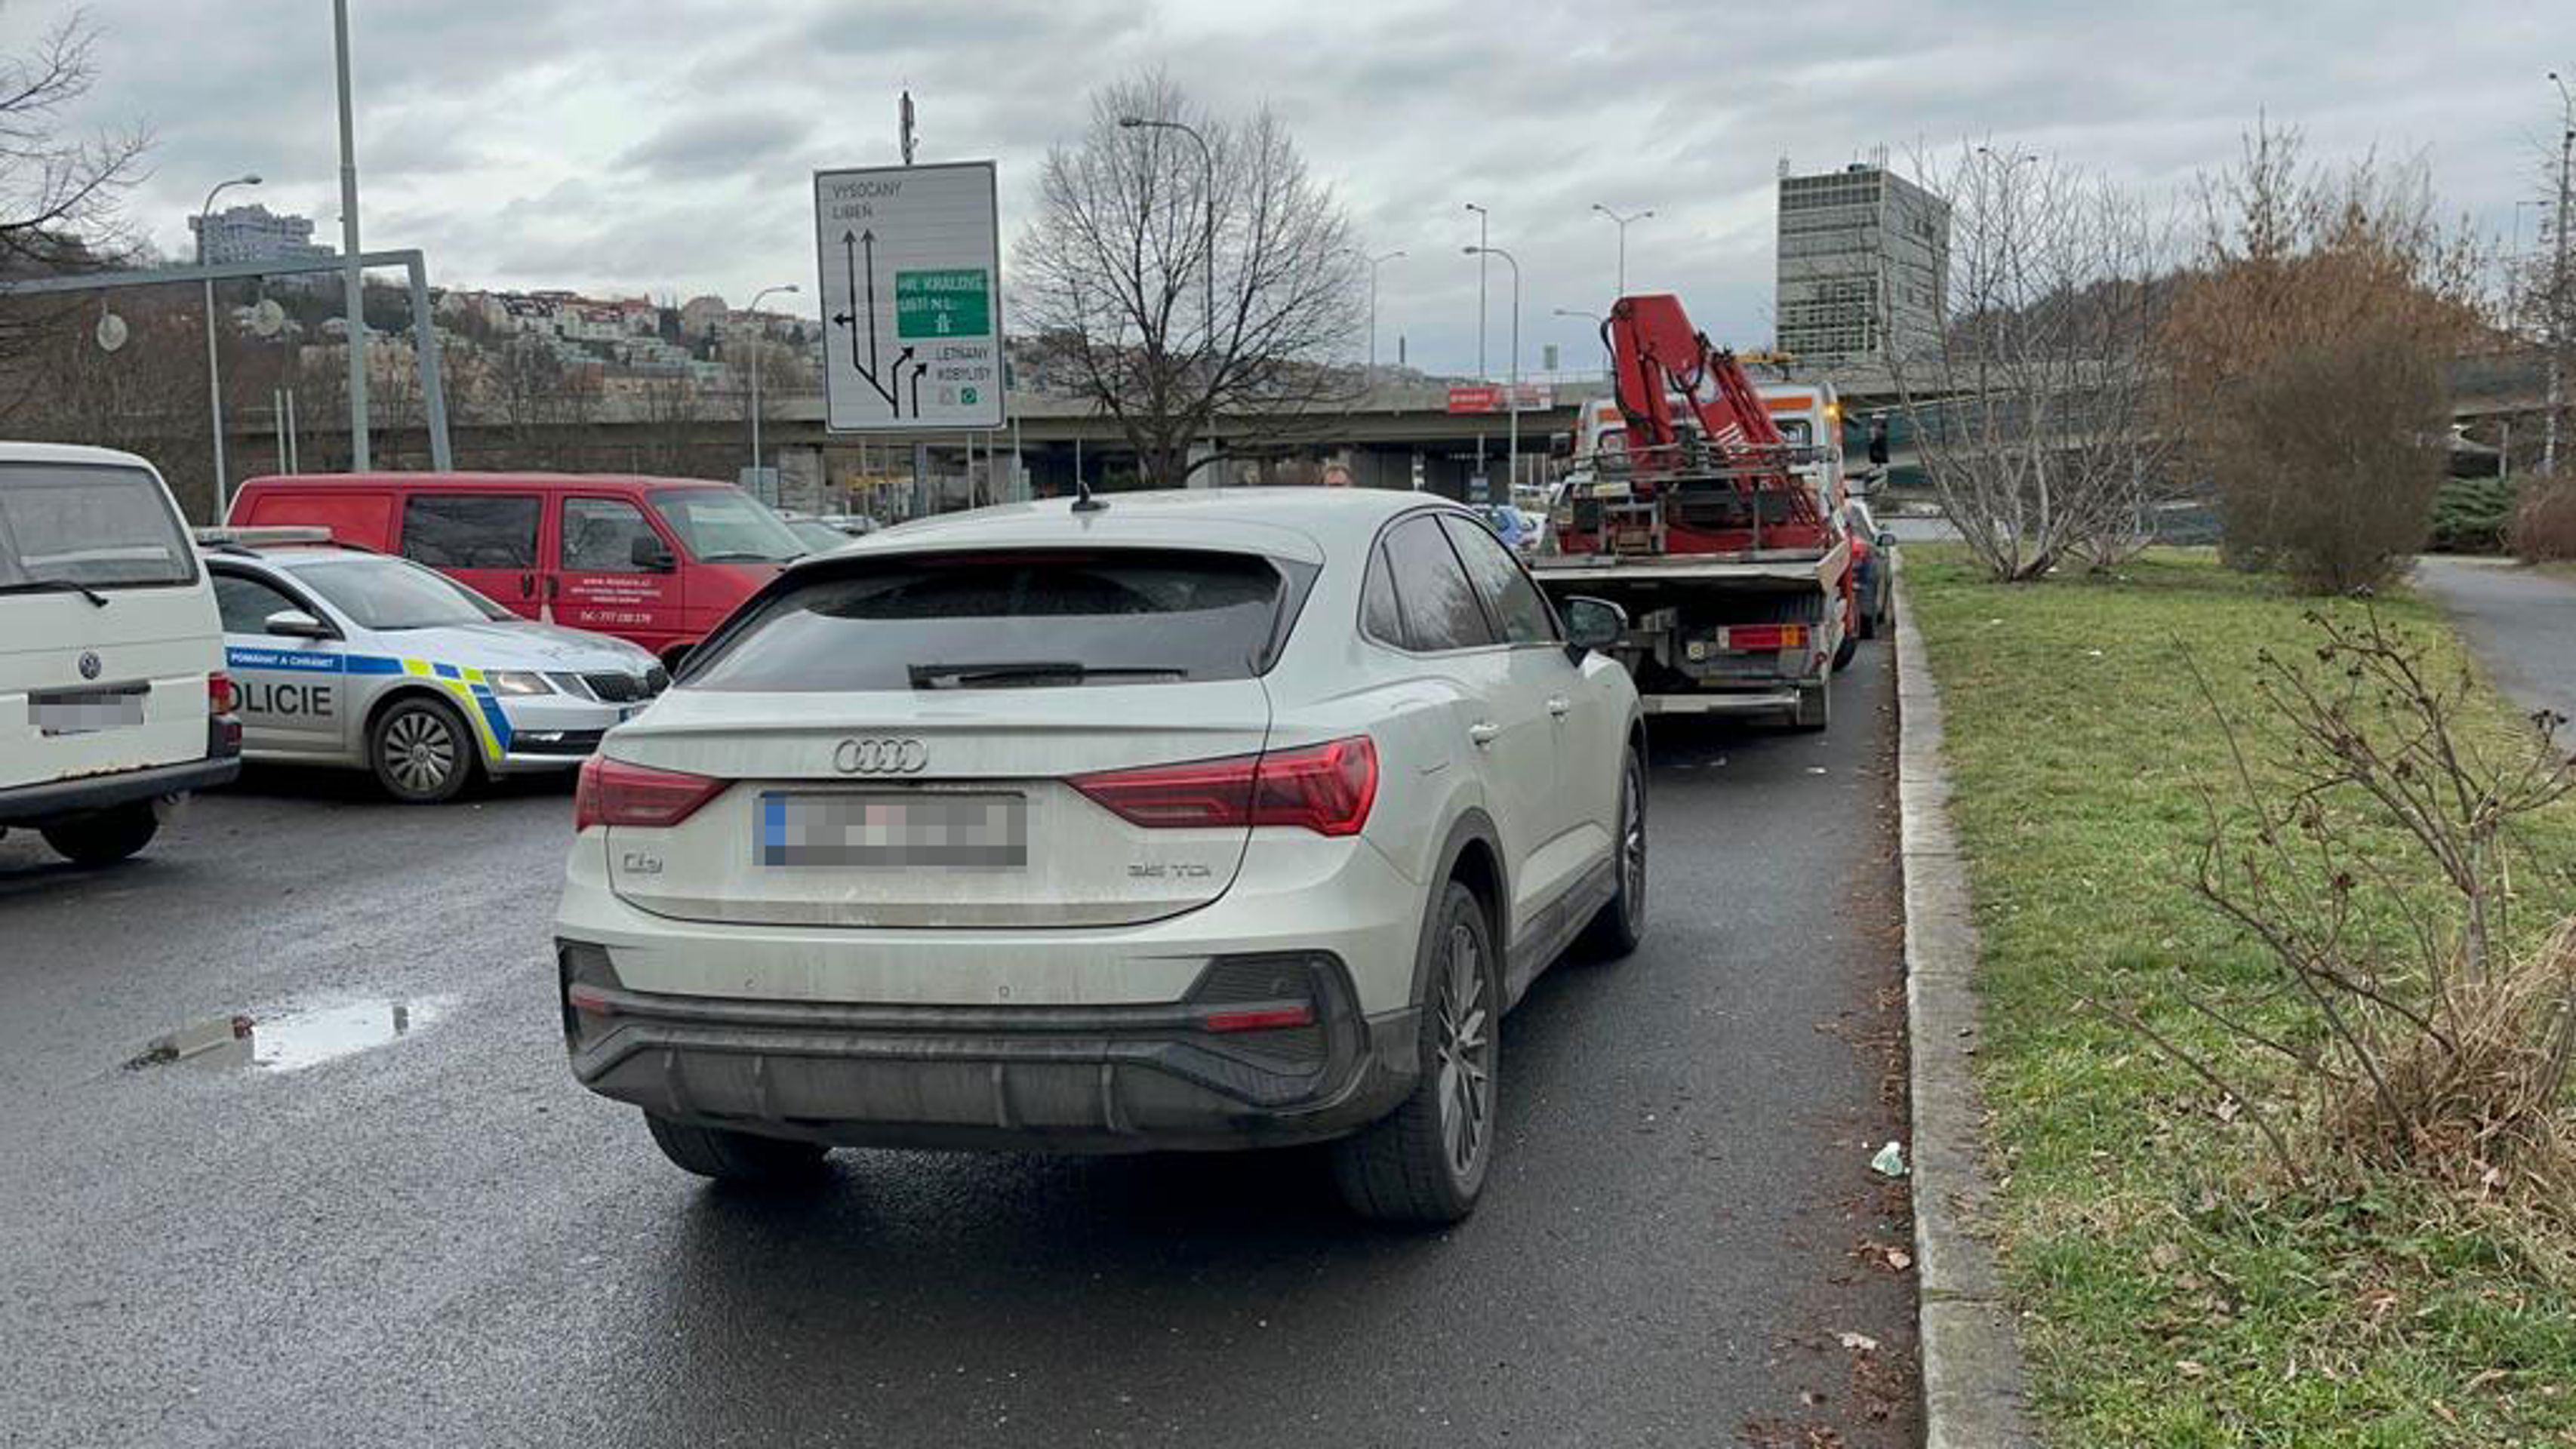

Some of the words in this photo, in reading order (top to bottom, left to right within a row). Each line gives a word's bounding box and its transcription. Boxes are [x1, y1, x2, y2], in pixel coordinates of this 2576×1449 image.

[229, 681, 333, 715] OLICIE
[1127, 864, 1167, 878] 35
[1170, 864, 1211, 878] TDI
